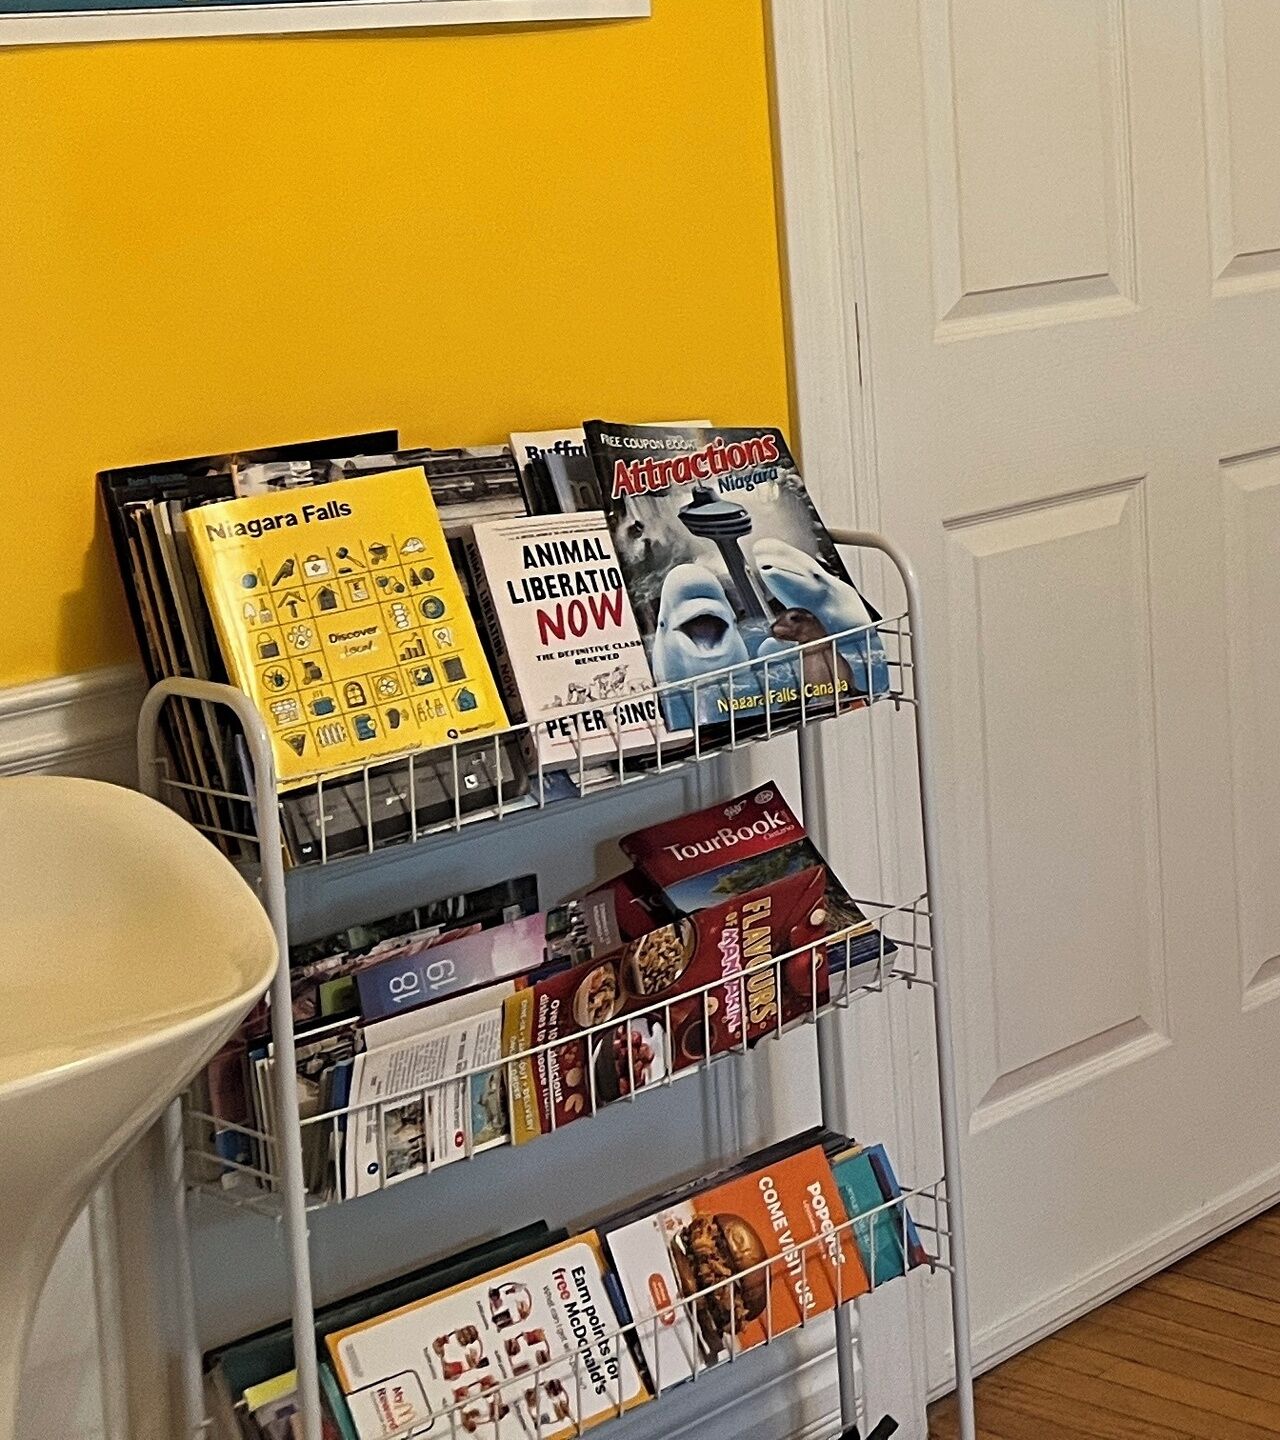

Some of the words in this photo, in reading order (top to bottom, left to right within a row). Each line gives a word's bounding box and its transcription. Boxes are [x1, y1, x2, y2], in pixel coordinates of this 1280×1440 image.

[600, 432, 623, 449] FREE
[623, 436, 665, 451] COUPON
[611, 434, 780, 500] Attractions
[717, 467, 778, 494] Niagara
[205, 512, 298, 543] Niagara
[302, 500, 352, 524] Falls
[522, 537, 611, 571] ANIMAL
[506, 566, 623, 605] LIBERATIO
[466, 541, 486, 590] ANIMAL
[479, 590, 504, 657] LIBERATION
[500, 662, 517, 700] NOW
[536, 586, 624, 647] NOW
[328, 625, 378, 644] Discover
[536, 652, 555, 662] THE
[557, 643, 611, 659] DEFINITIVE
[612, 639, 644, 650] CLASS
[574, 652, 620, 666] RENEWED
[545, 707, 608, 740] PETER
[612, 699, 661, 728] SING
[716, 694, 766, 714] Nagara
[662, 809, 787, 862] TourBook
[426, 959, 458, 991] 19
[742, 895, 778, 1024] FLAVOURS
[388, 971, 421, 1004] 18
[537, 993, 550, 1029] dishes
[550, 999, 561, 1027] Over
[536, 1029, 546, 1043] to
[536, 1047, 547, 1086] hoose
[758, 1176, 789, 1233] COME
[551, 1267, 571, 1301] free
[571, 1265, 592, 1304] Earn
